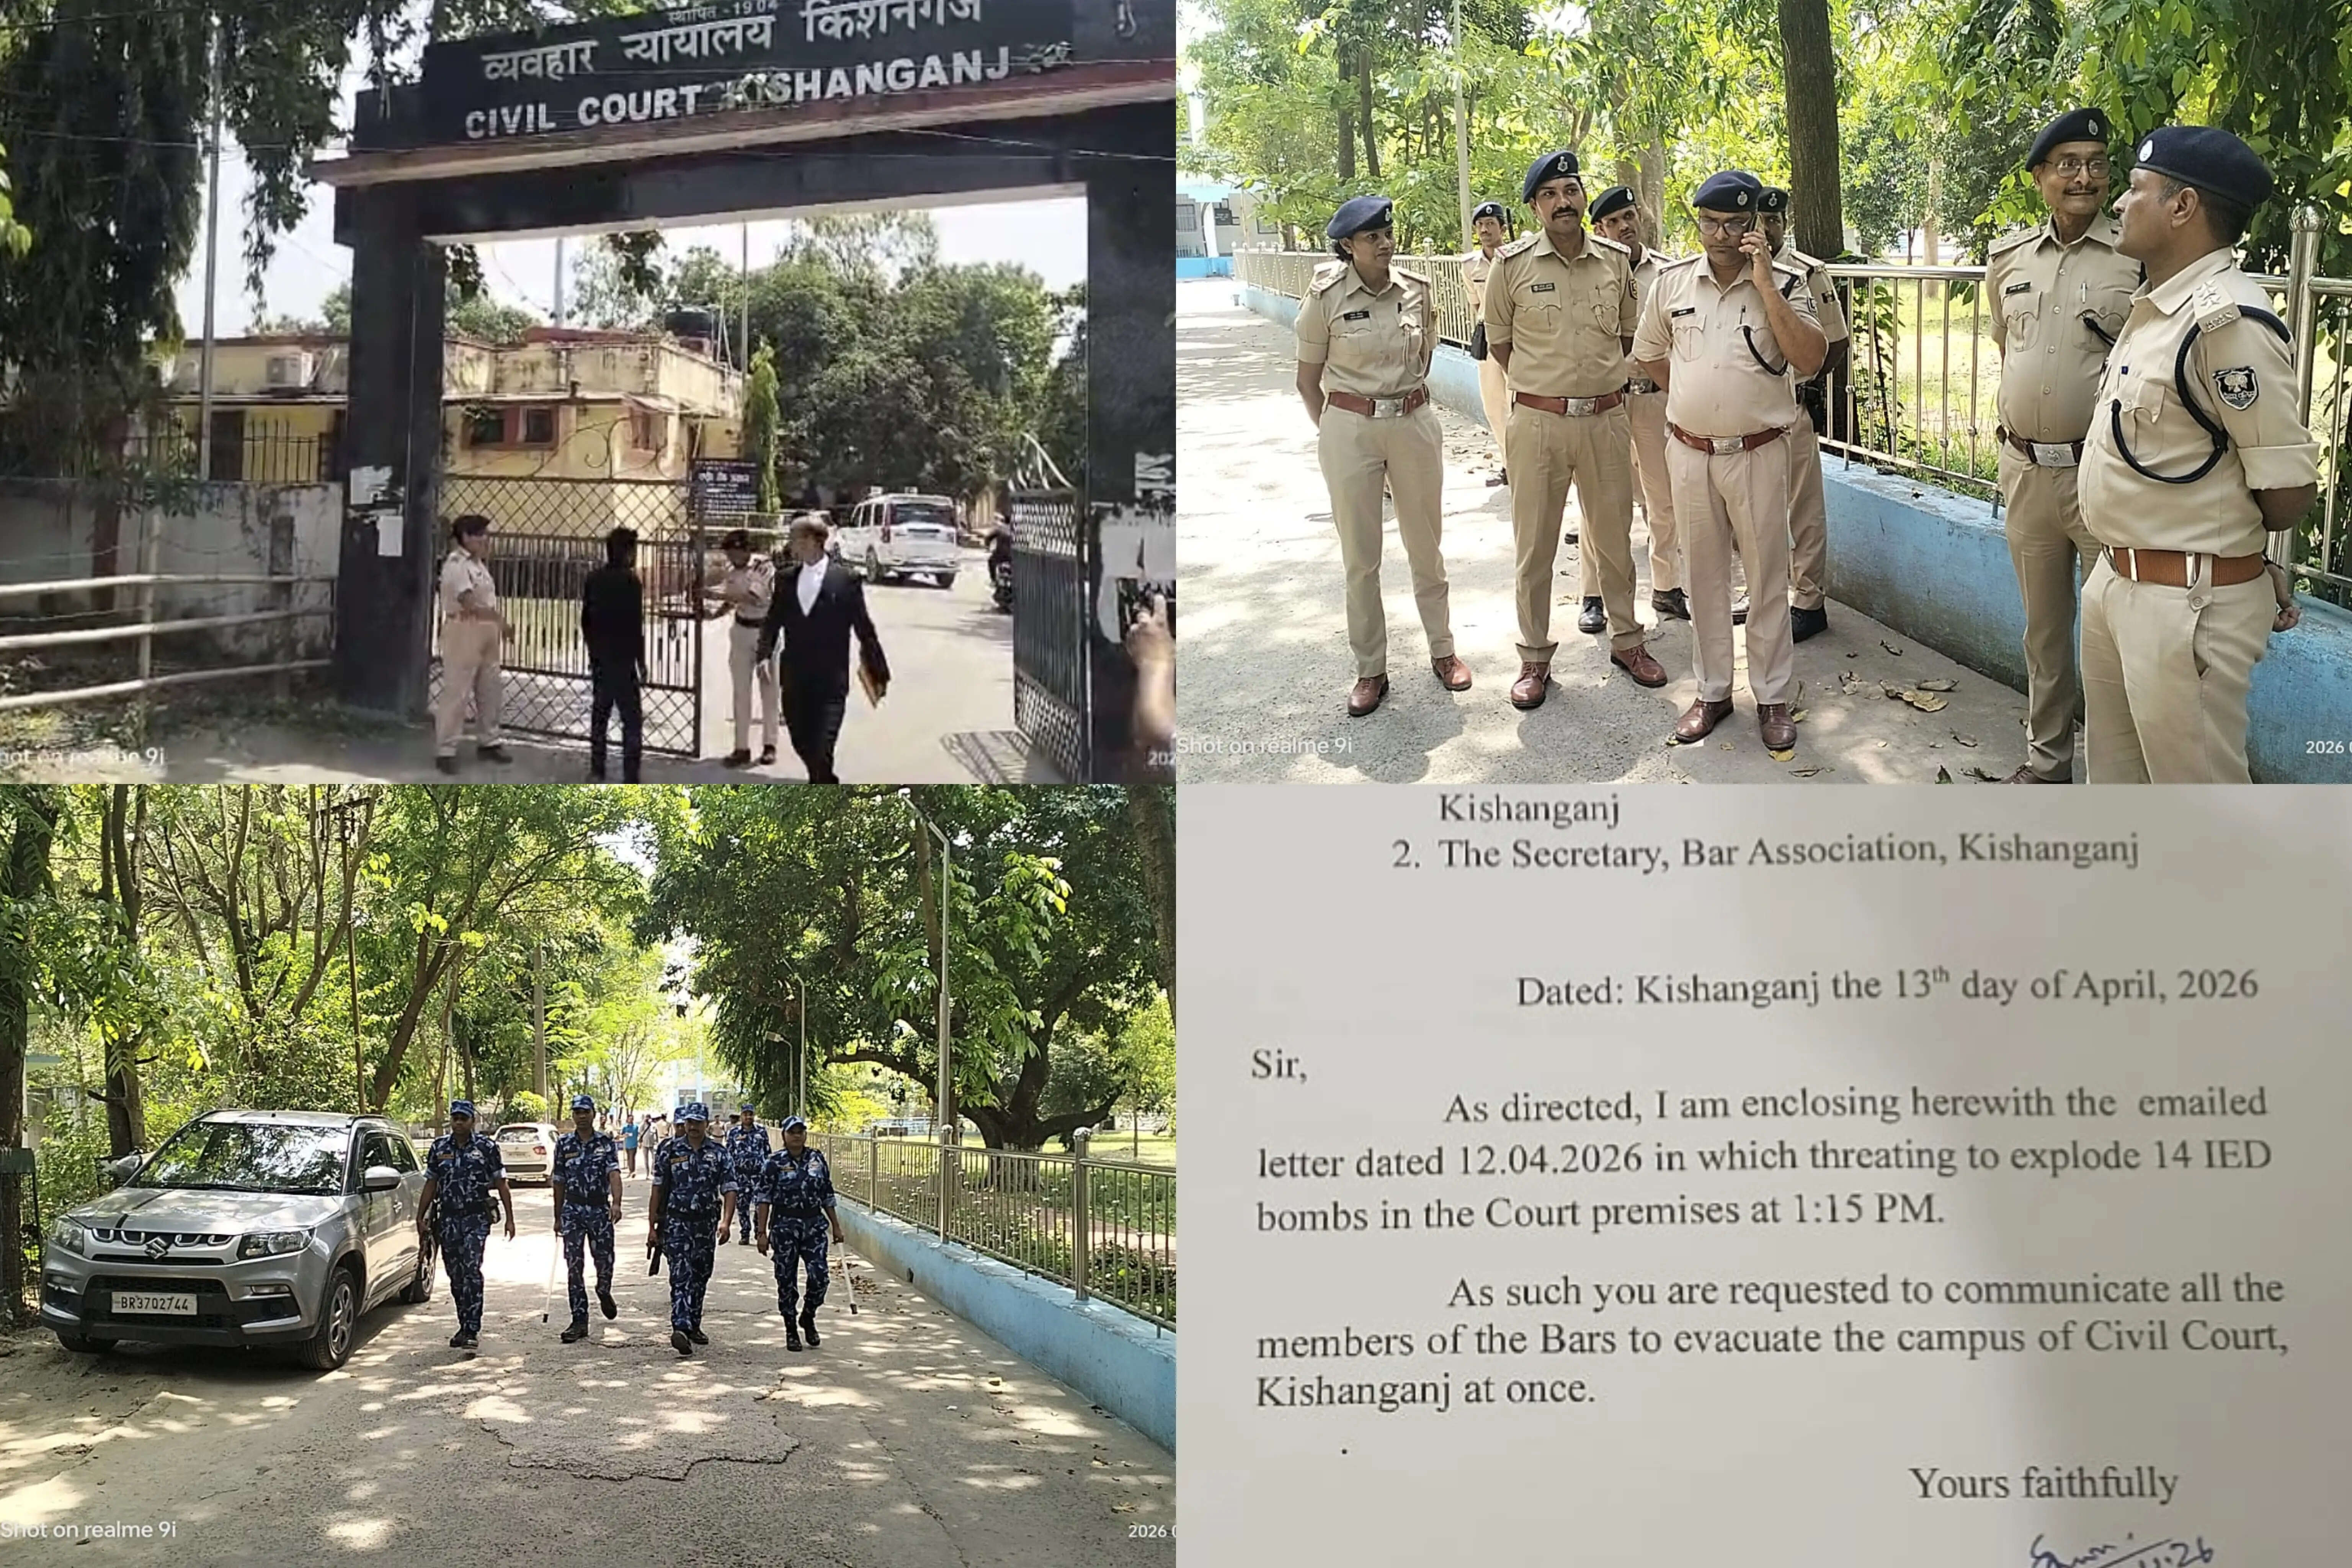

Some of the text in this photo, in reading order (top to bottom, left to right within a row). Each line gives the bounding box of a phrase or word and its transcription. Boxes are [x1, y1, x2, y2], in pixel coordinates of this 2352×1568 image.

[481, 40, 599, 81] व्यवहार
[620, 15, 776, 64] न्यायालय
[465, 103, 557, 139] CIVIL
[578, 84, 703, 127] COURT
[1440, 792, 1619, 830] Kishanganj
[1392, 832, 2138, 875] 2. The Secretary, Bar Association, Kishanganj
[1517, 975, 1623, 1006] Dated:
[1635, 971, 1819, 1009] Kishanganj
[1831, 970, 1882, 1000] the
[1962, 969, 2018, 1006] day
[2030, 969, 2069, 999] of
[2072, 969, 2166, 1007] April,
[2177, 969, 2258, 999] 2026
[1252, 1048, 1307, 1084] Sir,
[1442, 1086, 2268, 1126] As directed, I am enclosing herewith the emailed
[1258, 1138, 2271, 1179] letter dated 12.04.2026 in which threating to explode 14 IED
[1256, 1193, 1944, 1235] bombs in the Court premises at 1:15 PM.
[1447, 1272, 2285, 1314] As such you are requested to communicate all the
[1256, 1320, 2288, 1361] members of the Bars to evacuate the campus of Civil Court,
[1256, 1372, 1595, 1413] Kishanganj at once.
[1908, 1466, 2179, 1506] Yours faithfully
